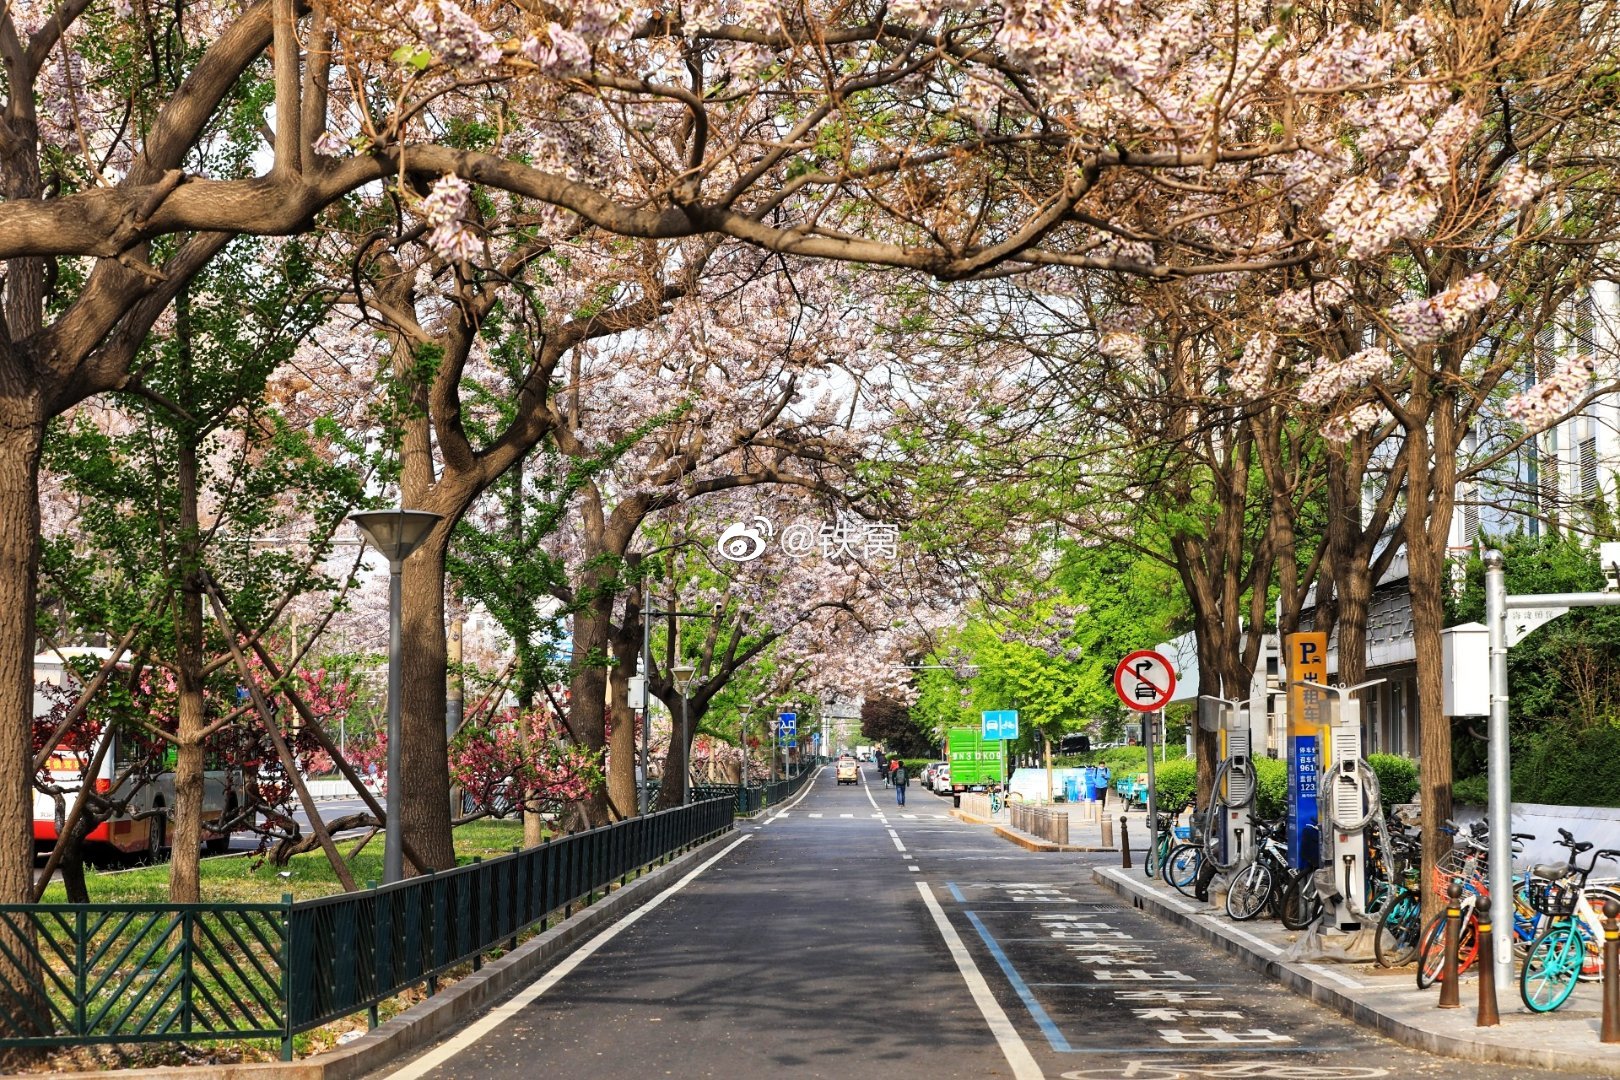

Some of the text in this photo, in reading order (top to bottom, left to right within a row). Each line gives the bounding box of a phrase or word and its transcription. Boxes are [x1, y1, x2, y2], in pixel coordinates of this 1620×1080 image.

[1300, 642, 1317, 664] P
[780, 720, 795, 730] 入口
[1300, 764, 1316, 772] 961
